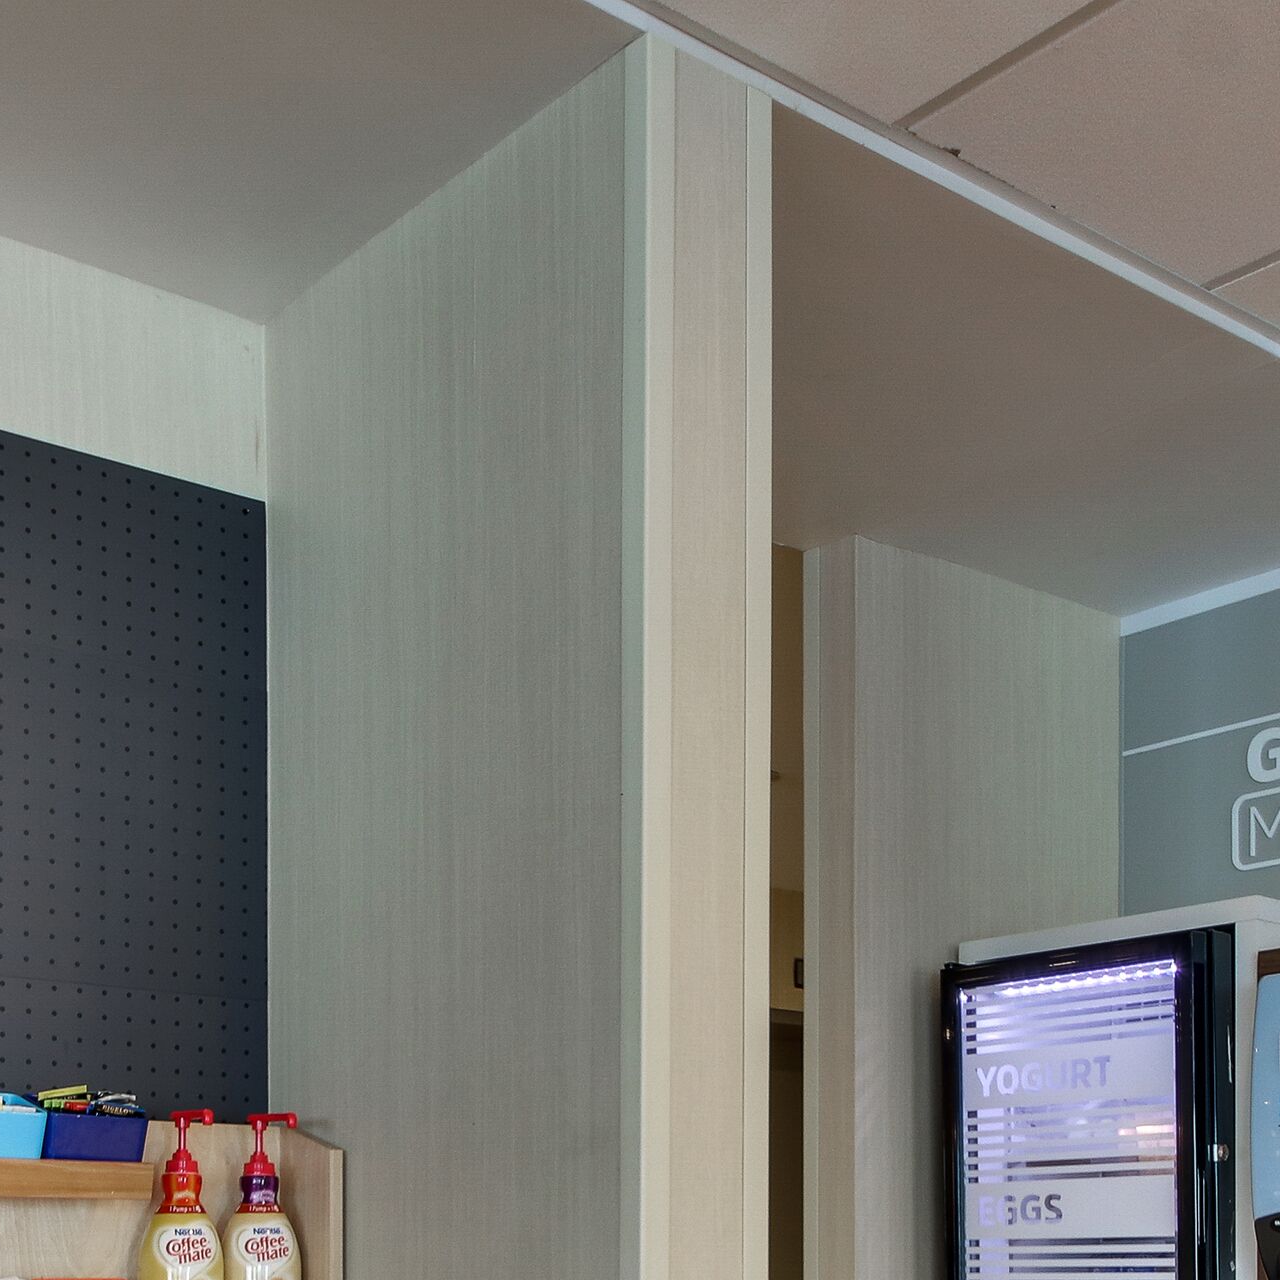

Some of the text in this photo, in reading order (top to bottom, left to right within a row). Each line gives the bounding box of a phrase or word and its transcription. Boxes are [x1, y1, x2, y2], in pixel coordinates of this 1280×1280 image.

[976, 1055, 1111, 1097] YOGURT
[978, 1194, 1063, 1226] EGGS
[178, 1248, 212, 1264] mate
[256, 1245, 289, 1262] mate
